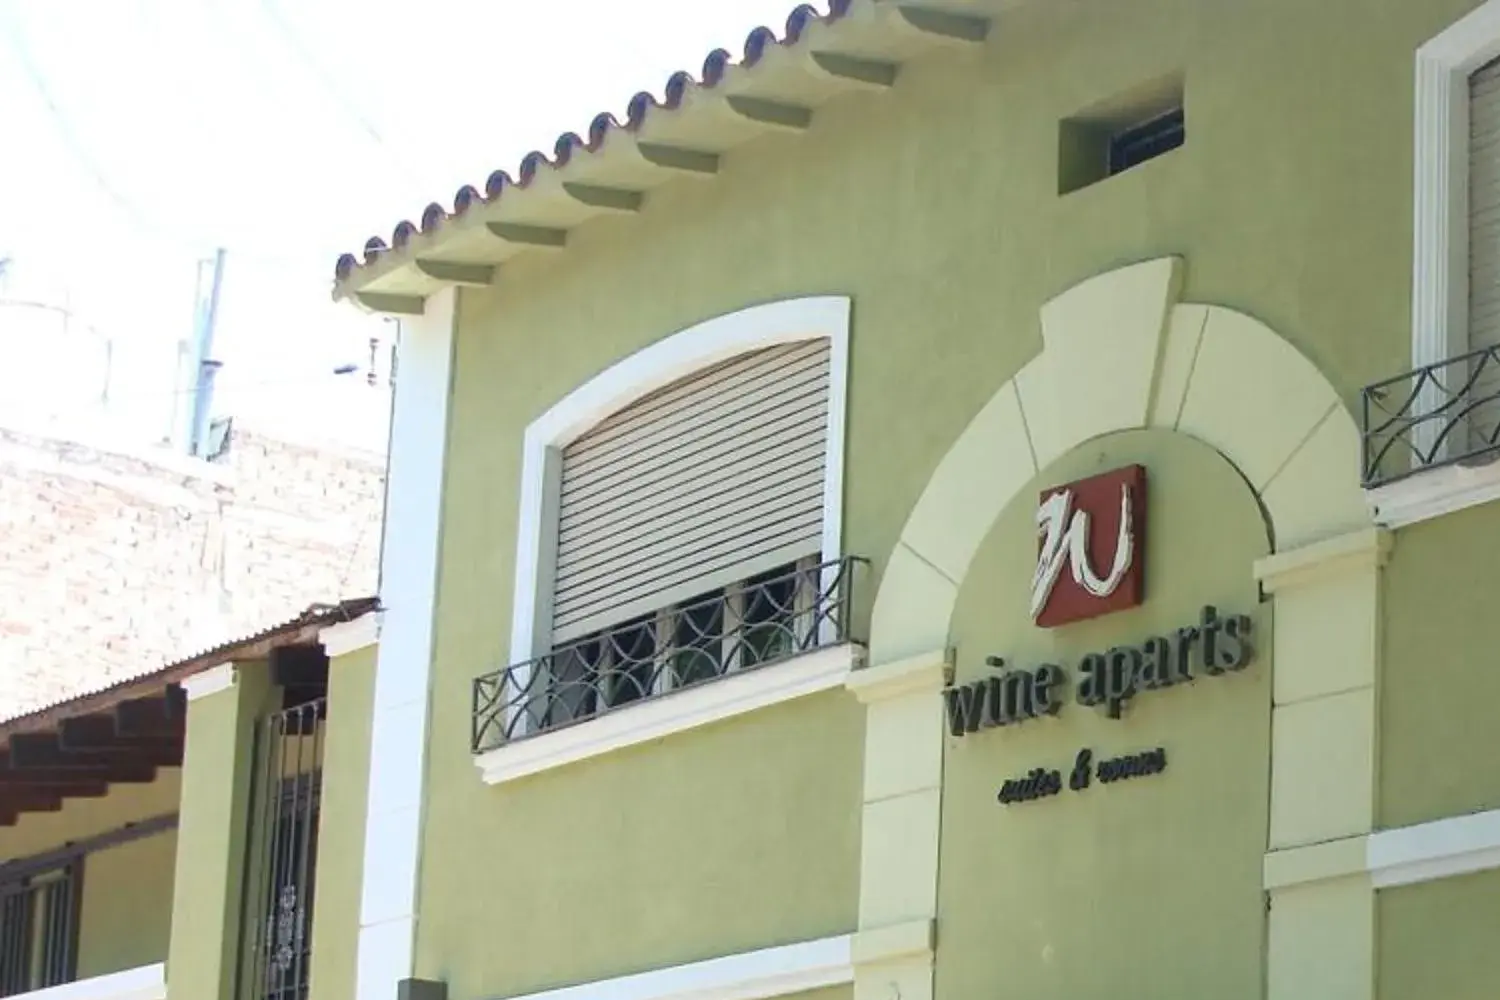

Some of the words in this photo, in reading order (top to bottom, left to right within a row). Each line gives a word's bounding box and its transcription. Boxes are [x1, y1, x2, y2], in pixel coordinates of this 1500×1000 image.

[942, 655, 1062, 736] wine
[1076, 605, 1254, 719] aparts
[1069, 748, 1092, 791] &
